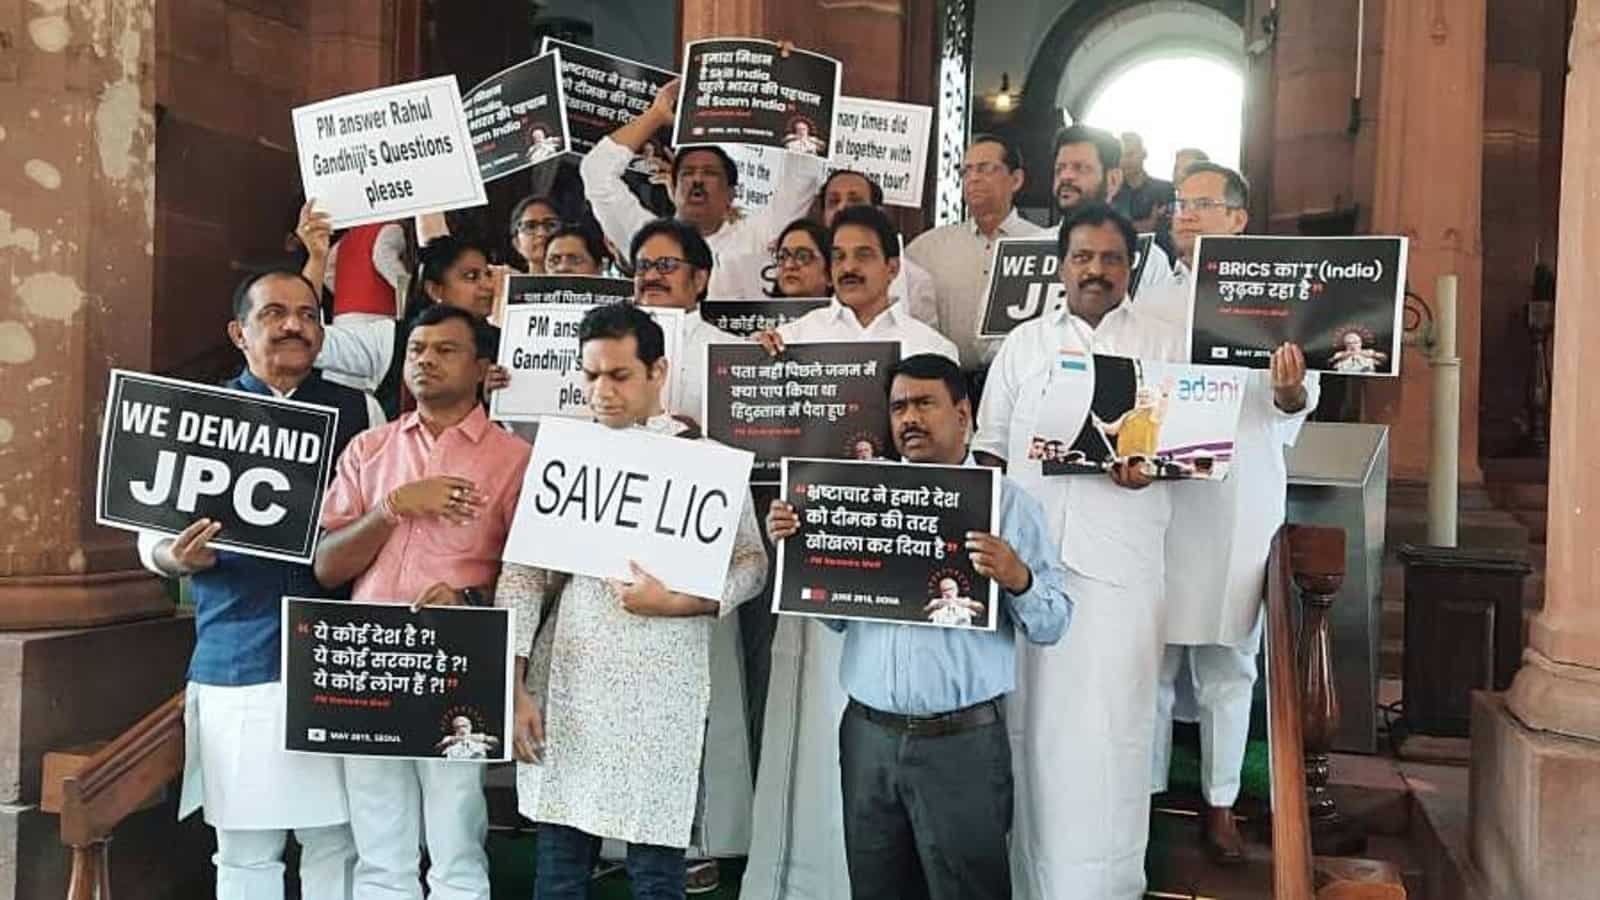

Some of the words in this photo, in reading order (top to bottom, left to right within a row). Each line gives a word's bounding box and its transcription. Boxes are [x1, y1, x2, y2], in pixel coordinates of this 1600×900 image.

[736, 68, 770, 81] India
[316, 114, 336, 139] PM
[339, 109, 388, 135] answer
[389, 95, 433, 126] Rahul
[862, 111, 888, 132] times
[891, 113, 908, 134] did
[312, 143, 379, 177] Gandhiji's
[379, 134, 454, 164] Questions
[846, 138, 887, 161] together
[890, 143, 912, 163] with
[365, 178, 414, 209] please
[1002, 256, 1036, 276] WE
[1268, 282, 1296, 300] रहा
[528, 316, 550, 337] PM
[553, 321, 580, 337] ans
[512, 347, 583, 376] Gandhiji's
[559, 382, 588, 408] ple
[1178, 374, 1239, 401] adani
[122, 400, 170, 437] WE
[177, 411, 321, 464] DEMAND
[129, 450, 291, 526] JPC
[872, 484, 888, 504] ने
[890, 486, 930, 507] हमारे
[932, 486, 961, 509] देश
[535, 460, 649, 528] SAVE
[655, 479, 728, 544] LIC
[805, 505, 828, 526] को
[831, 505, 877, 527] दीमक
[880, 509, 903, 530] की
[905, 514, 940, 534] तरह
[805, 530, 863, 553] खोखला
[896, 534, 932, 557] दिया
[331, 621, 371, 645] कोई
[371, 624, 402, 646] देश
[404, 623, 418, 648] है
[312, 644, 329, 665] ये
[331, 646, 370, 669] कोई
[371, 651, 434, 670] सरकार
[435, 648, 449, 673] है
[312, 667, 329, 689] ये
[331, 670, 370, 692] कोई
[370, 672, 410, 693] लोग
